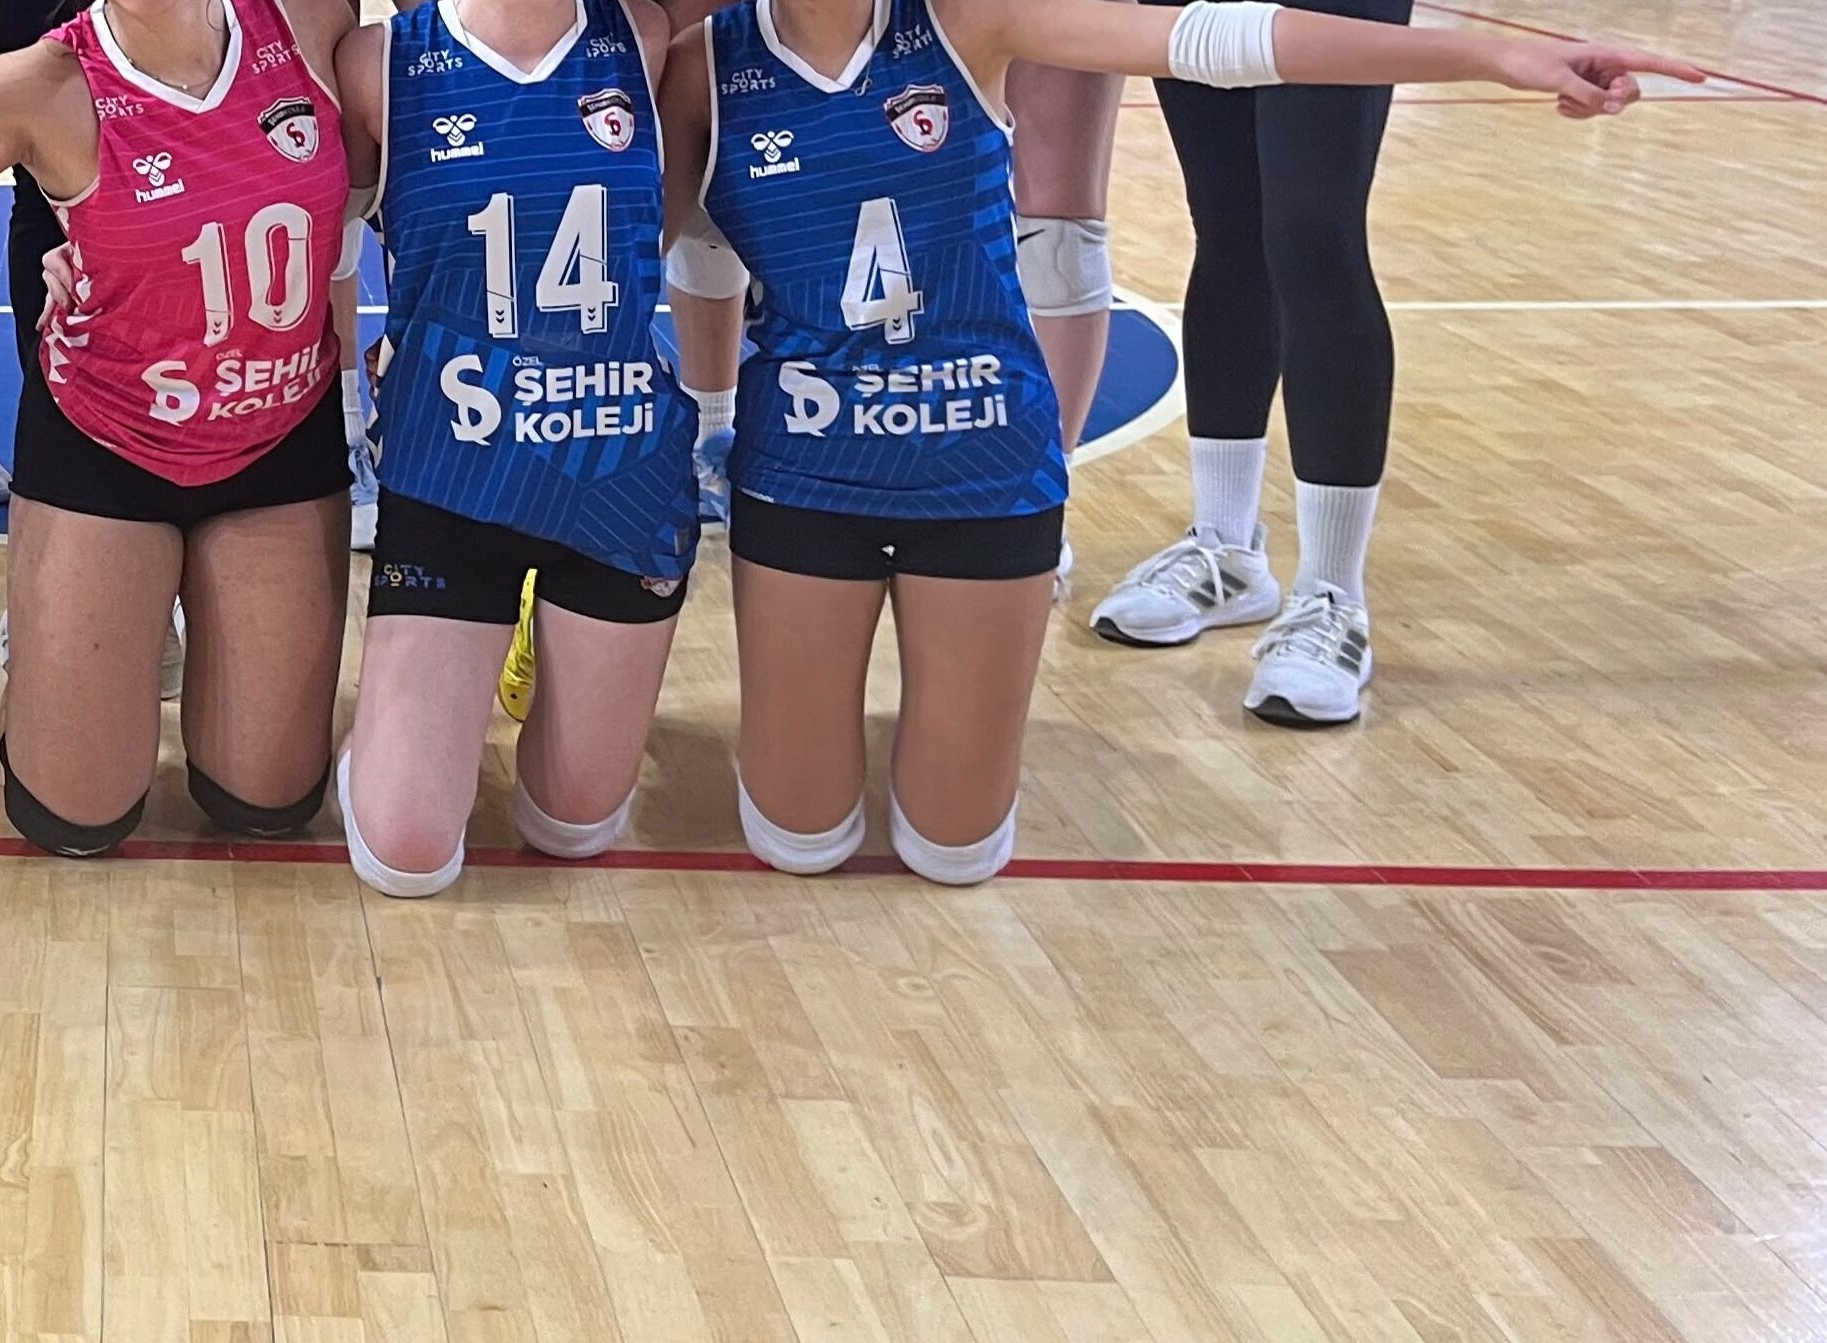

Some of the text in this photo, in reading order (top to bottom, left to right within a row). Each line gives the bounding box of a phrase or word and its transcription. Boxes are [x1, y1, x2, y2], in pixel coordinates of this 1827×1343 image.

[256, 40, 283, 59] CITY
[420, 49, 450, 64] CITY
[408, 57, 463, 77] SPORTS
[732, 68, 763, 83] CITY
[722, 77, 776, 95] SPORTS
[95, 95, 128, 108] CITY
[430, 141, 484, 163] hummel
[750, 157, 800, 179] hummel
[135, 179, 185, 203] hummel
[467, 184, 619, 338] 14
[841, 196, 923, 345] 4
[181, 202, 314, 348] 10
[514, 361, 653, 406] ŞEHİR
[854, 354, 1002, 398] ŞEHİR
[515, 402, 653, 443] KOLEJİ
[853, 394, 1008, 435] KOLEJİ
[384, 564, 424, 575] CITY
